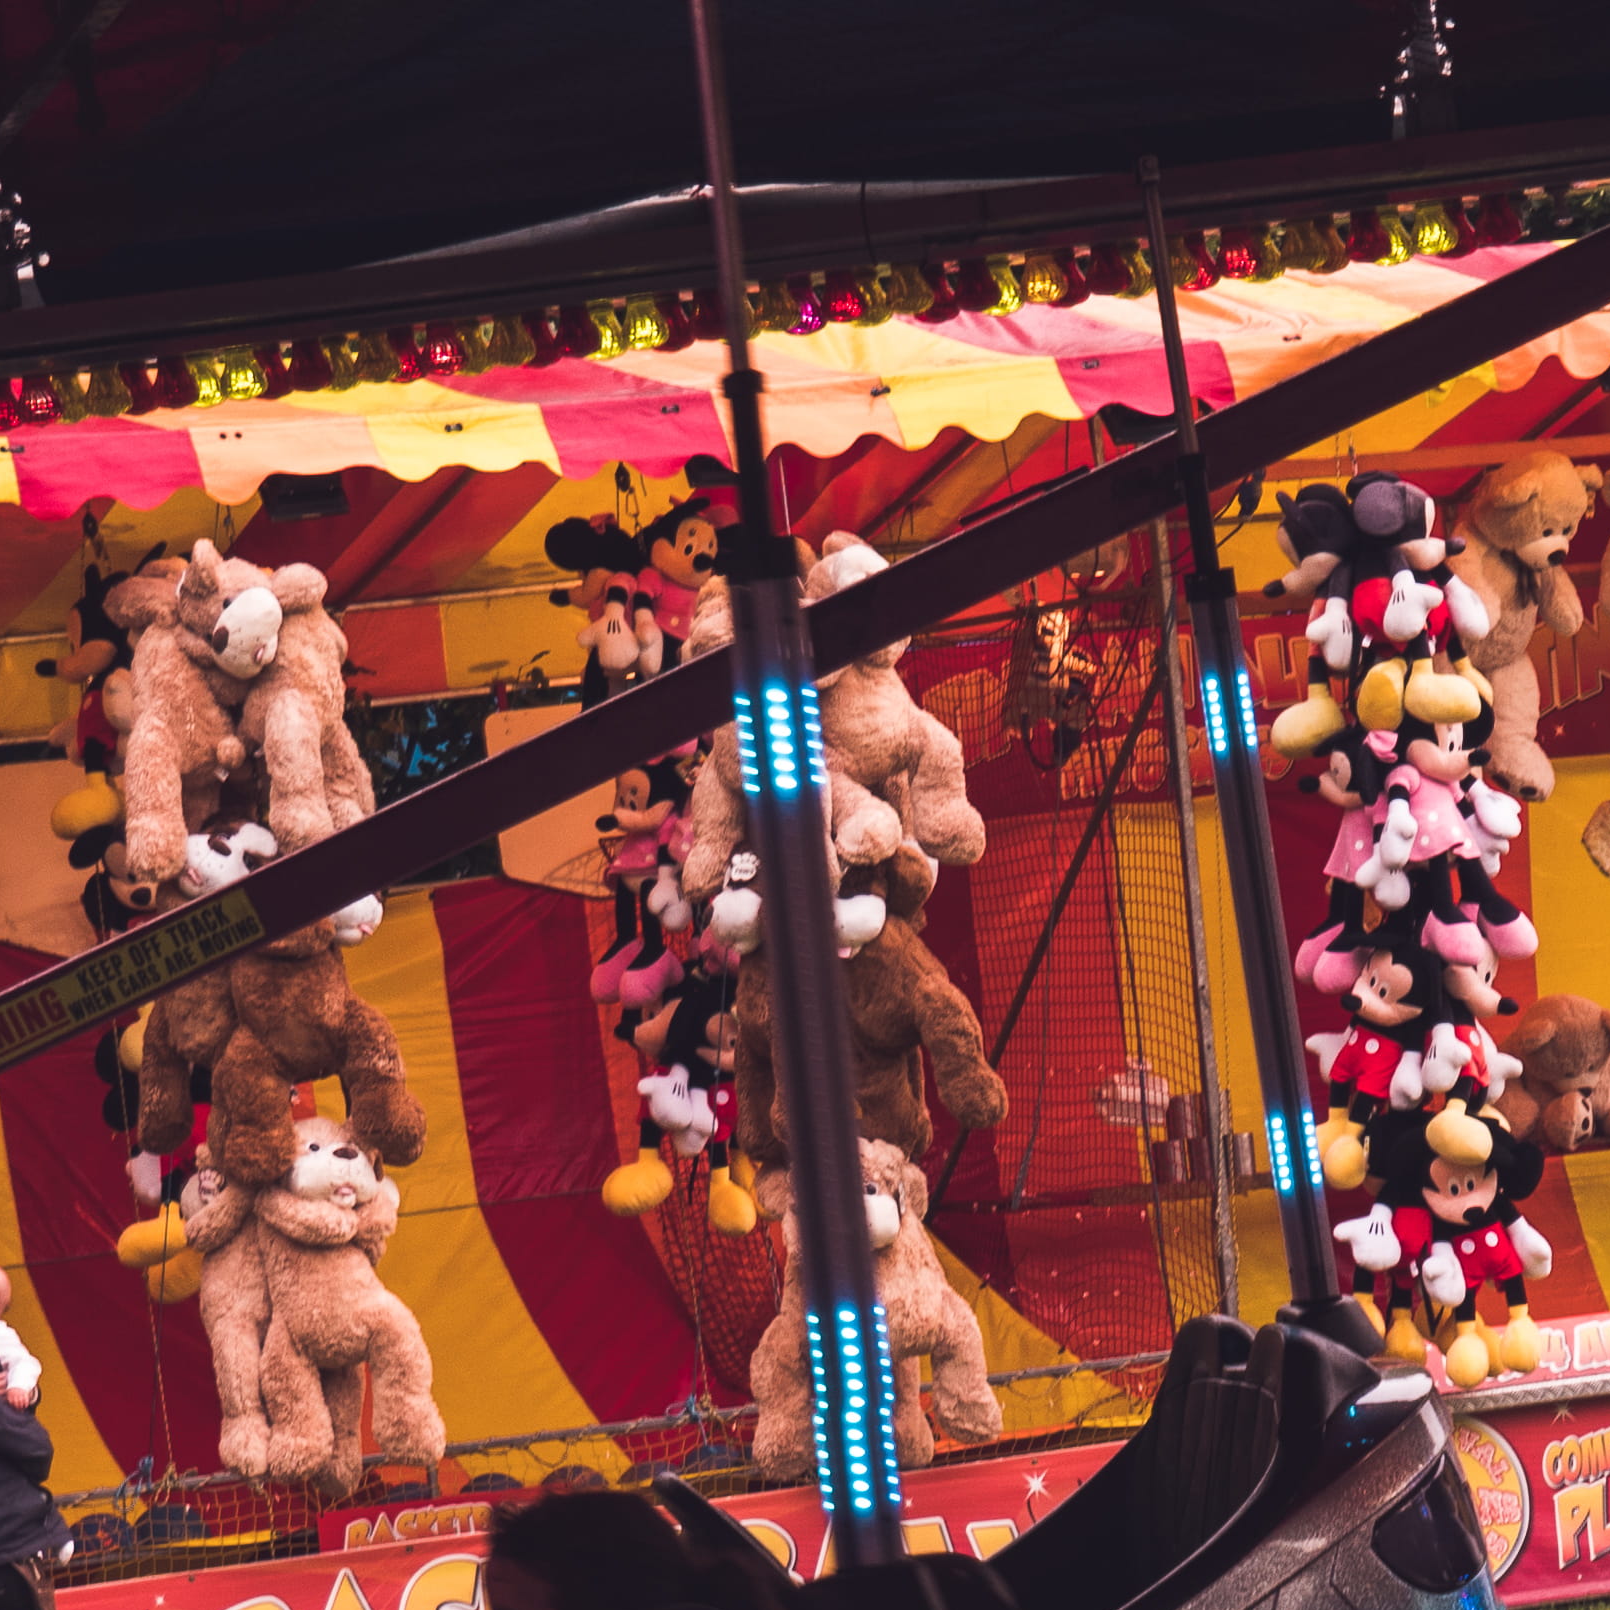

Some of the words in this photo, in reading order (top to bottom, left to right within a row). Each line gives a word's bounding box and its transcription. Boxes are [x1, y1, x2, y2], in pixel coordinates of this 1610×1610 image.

[68, 989, 114, 1022] WHEN
[117, 965, 161, 998] CARS
[165, 948, 197, 976] ARE
[199, 915, 260, 959] MOVING
[76, 955, 124, 992] KEEP
[129, 937, 163, 968] OFF
[169, 902, 231, 949] TRACK
[344, 1501, 494, 1552] BASKETB
